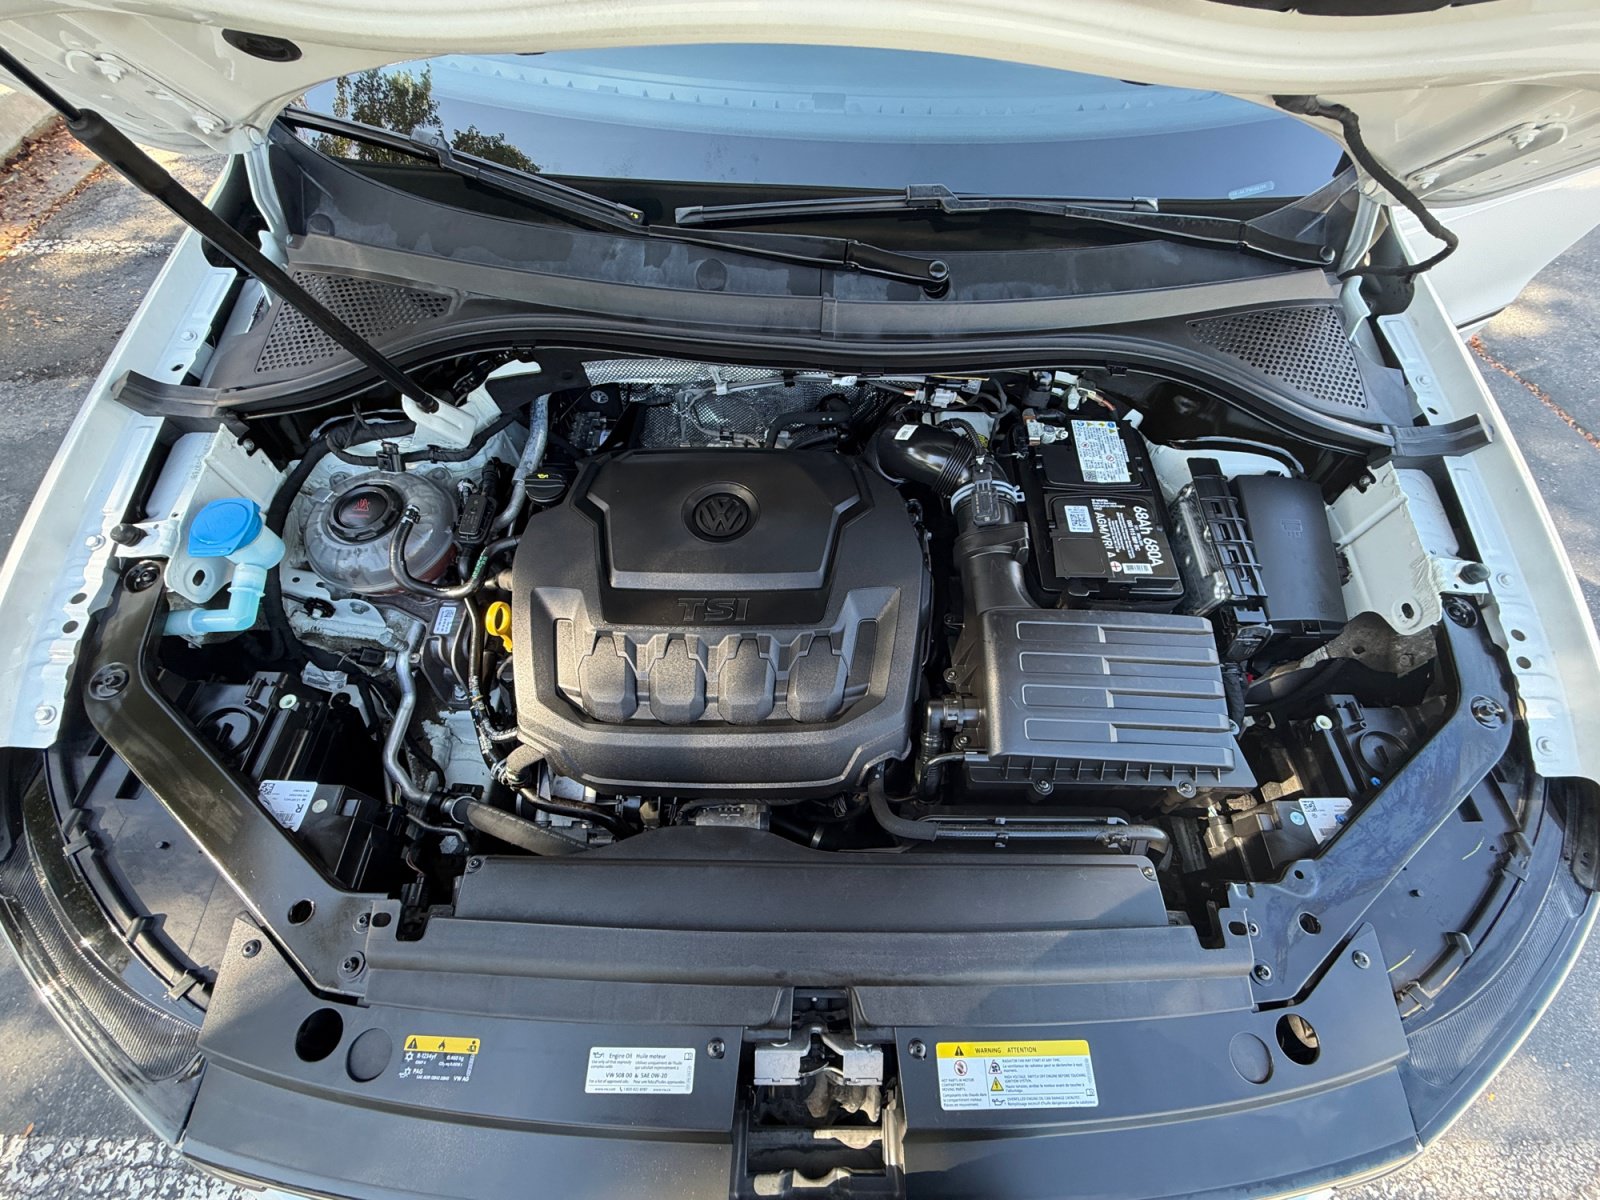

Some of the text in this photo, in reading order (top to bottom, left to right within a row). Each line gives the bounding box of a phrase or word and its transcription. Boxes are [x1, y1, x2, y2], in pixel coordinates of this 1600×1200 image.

[1133, 506, 1154, 534] 68Ah
[1143, 538, 1164, 566] 680A
[678, 598, 750, 622] TSI
[295, 804, 304, 813] R
